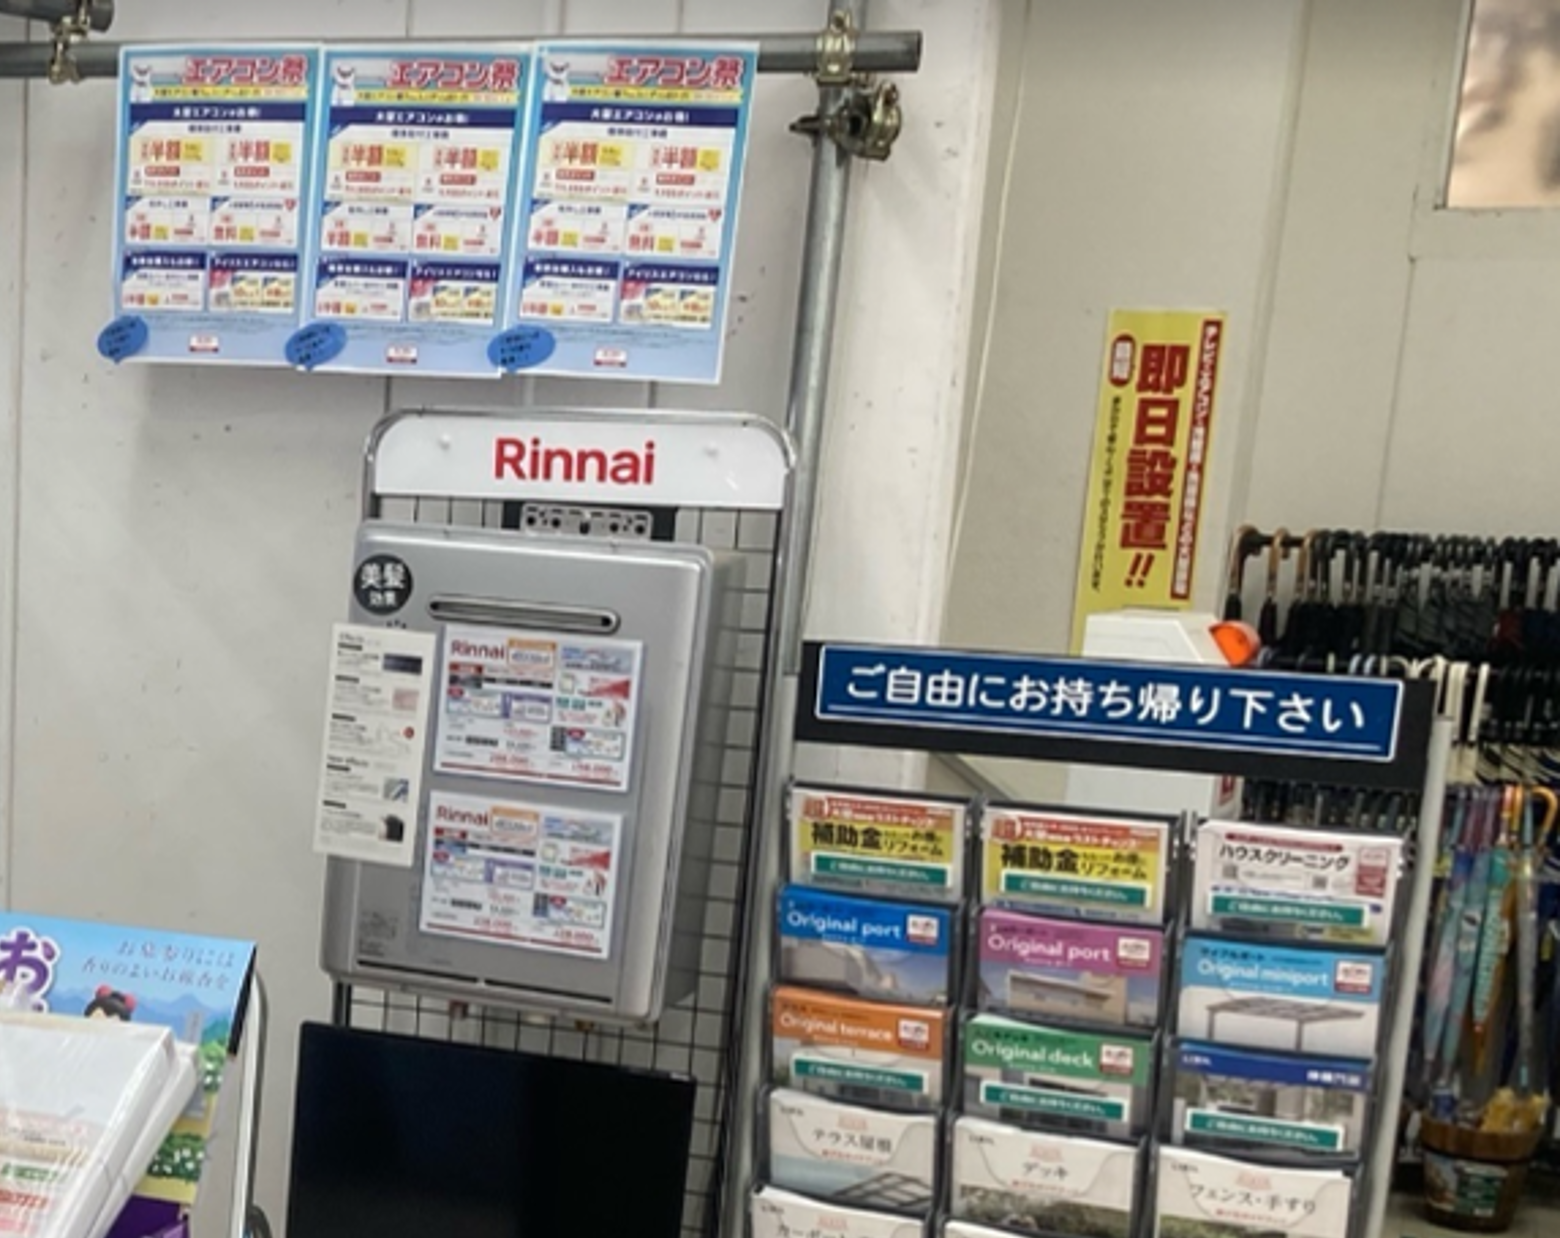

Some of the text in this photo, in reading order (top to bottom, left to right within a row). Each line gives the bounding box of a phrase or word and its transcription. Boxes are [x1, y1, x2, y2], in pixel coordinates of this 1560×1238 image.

[183, 55, 307, 85] エアコン祭
[387, 60, 517, 90] エアコン祭
[605, 55, 743, 88] エアコン祭
[494, 437, 656, 486] Rinnai
[451, 639, 504, 659] Rinnai
[846, 663, 1365, 734] ご自由にお持ち帰り下さい
[437, 805, 488, 826] Rinnai
[812, 822, 882, 850] 補助金
[885, 840, 943, 856] リフォーム
[1001, 844, 1079, 873] 補助金
[1082, 862, 1146, 879] リフォーム
[1219, 844, 1349, 871] ハウスクリーニング
[787, 911, 900, 939] Original port
[117, 940, 235, 968] お墓参りには
[988, 934, 1110, 961] Original port
[1198, 960, 1328, 986] Original miniport
[780, 1012, 892, 1041] Original terrace
[972, 1039, 1092, 1068] Original deck
[812, 1127, 891, 1153] テラス屋根
[1022, 1161, 1068, 1179] デッキ
[1190, 1184, 1315, 1214] フェンス・手すり
